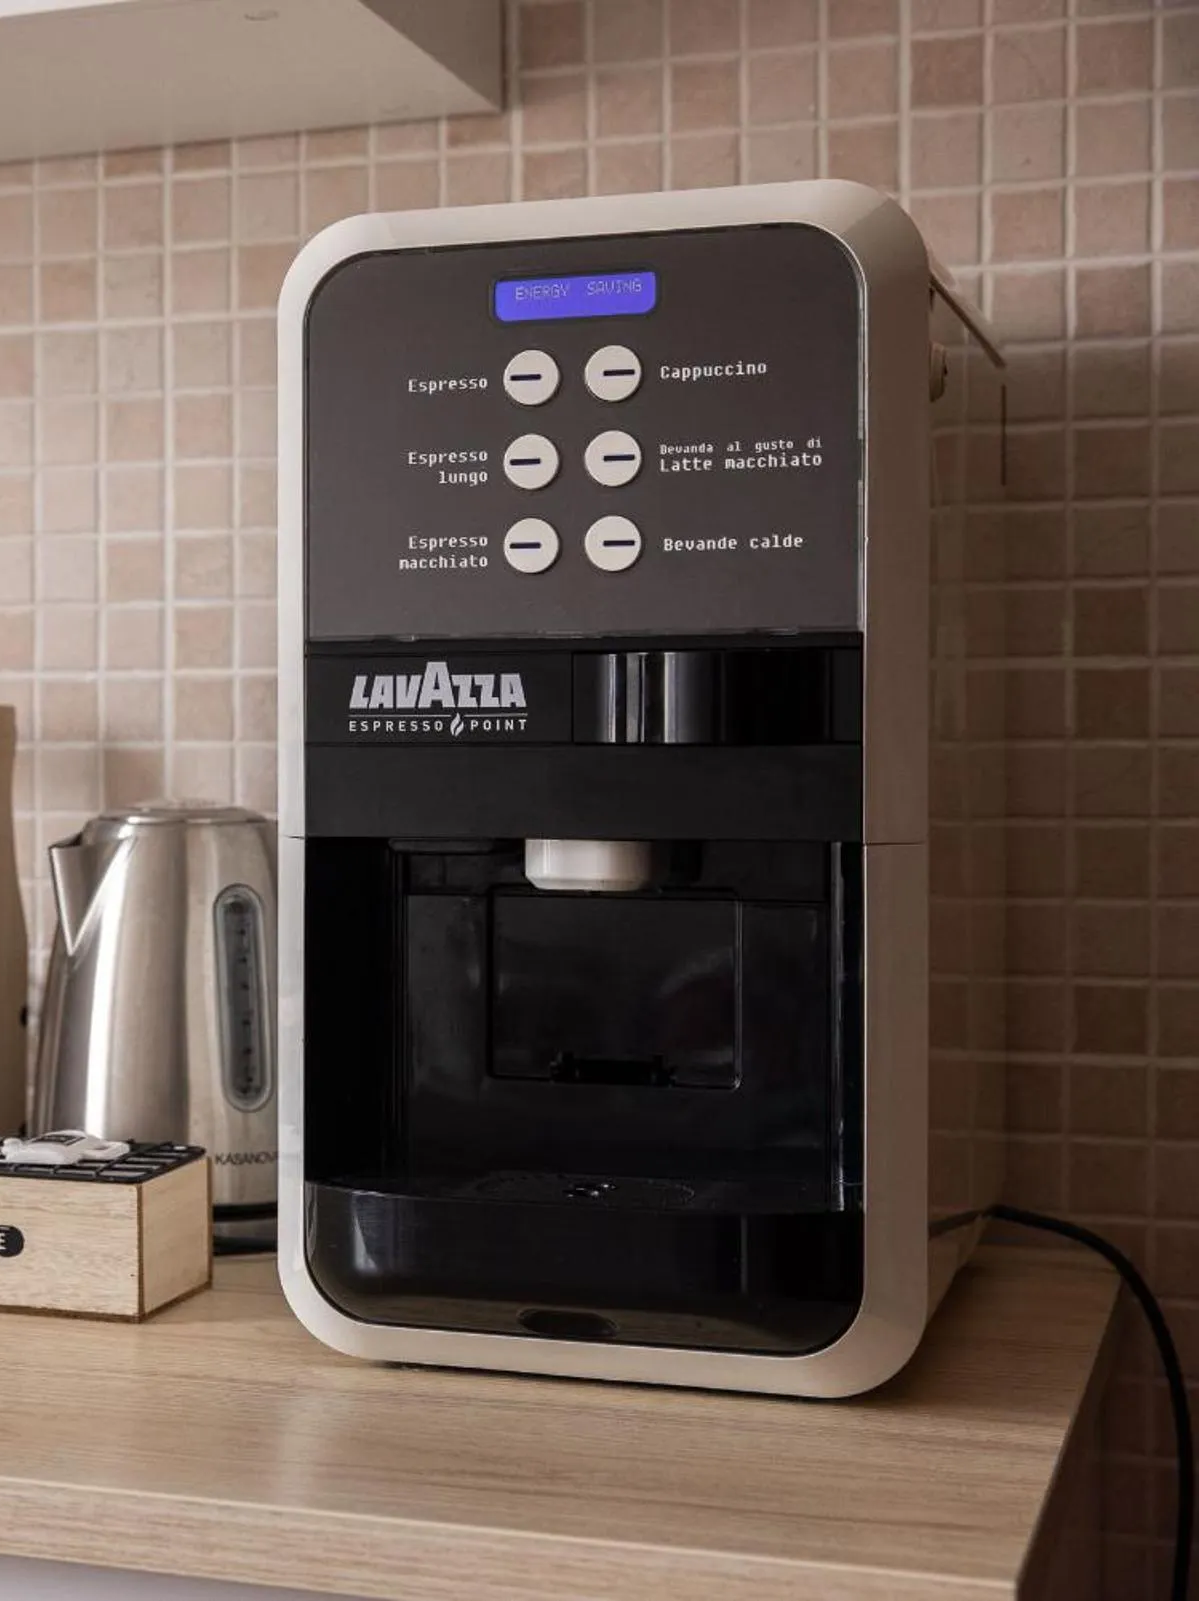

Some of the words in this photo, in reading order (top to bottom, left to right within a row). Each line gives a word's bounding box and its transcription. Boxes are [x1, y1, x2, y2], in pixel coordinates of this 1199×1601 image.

[515, 283, 570, 300] ENERGY
[586, 278, 642, 296] SAVING
[660, 360, 767, 381] Cappuccino
[408, 378, 488, 395] Espresso
[659, 443, 714, 454] Bevanda
[726, 441, 742, 452] al
[755, 439, 794, 453] gusto
[806, 436, 823, 449] di
[408, 450, 488, 467] Espresso
[660, 457, 713, 472] Latte
[725, 452, 822, 470] macchiato
[439, 471, 488, 487] lungo
[408, 536, 488, 552] Espresso
[664, 536, 738, 551] Bevande
[750, 534, 803, 549] calde
[399, 554, 488, 569] macchiato
[349, 661, 527, 708] LAVAZZA
[349, 720, 443, 732] ESPRESSO
[470, 719, 527, 731] POINT
